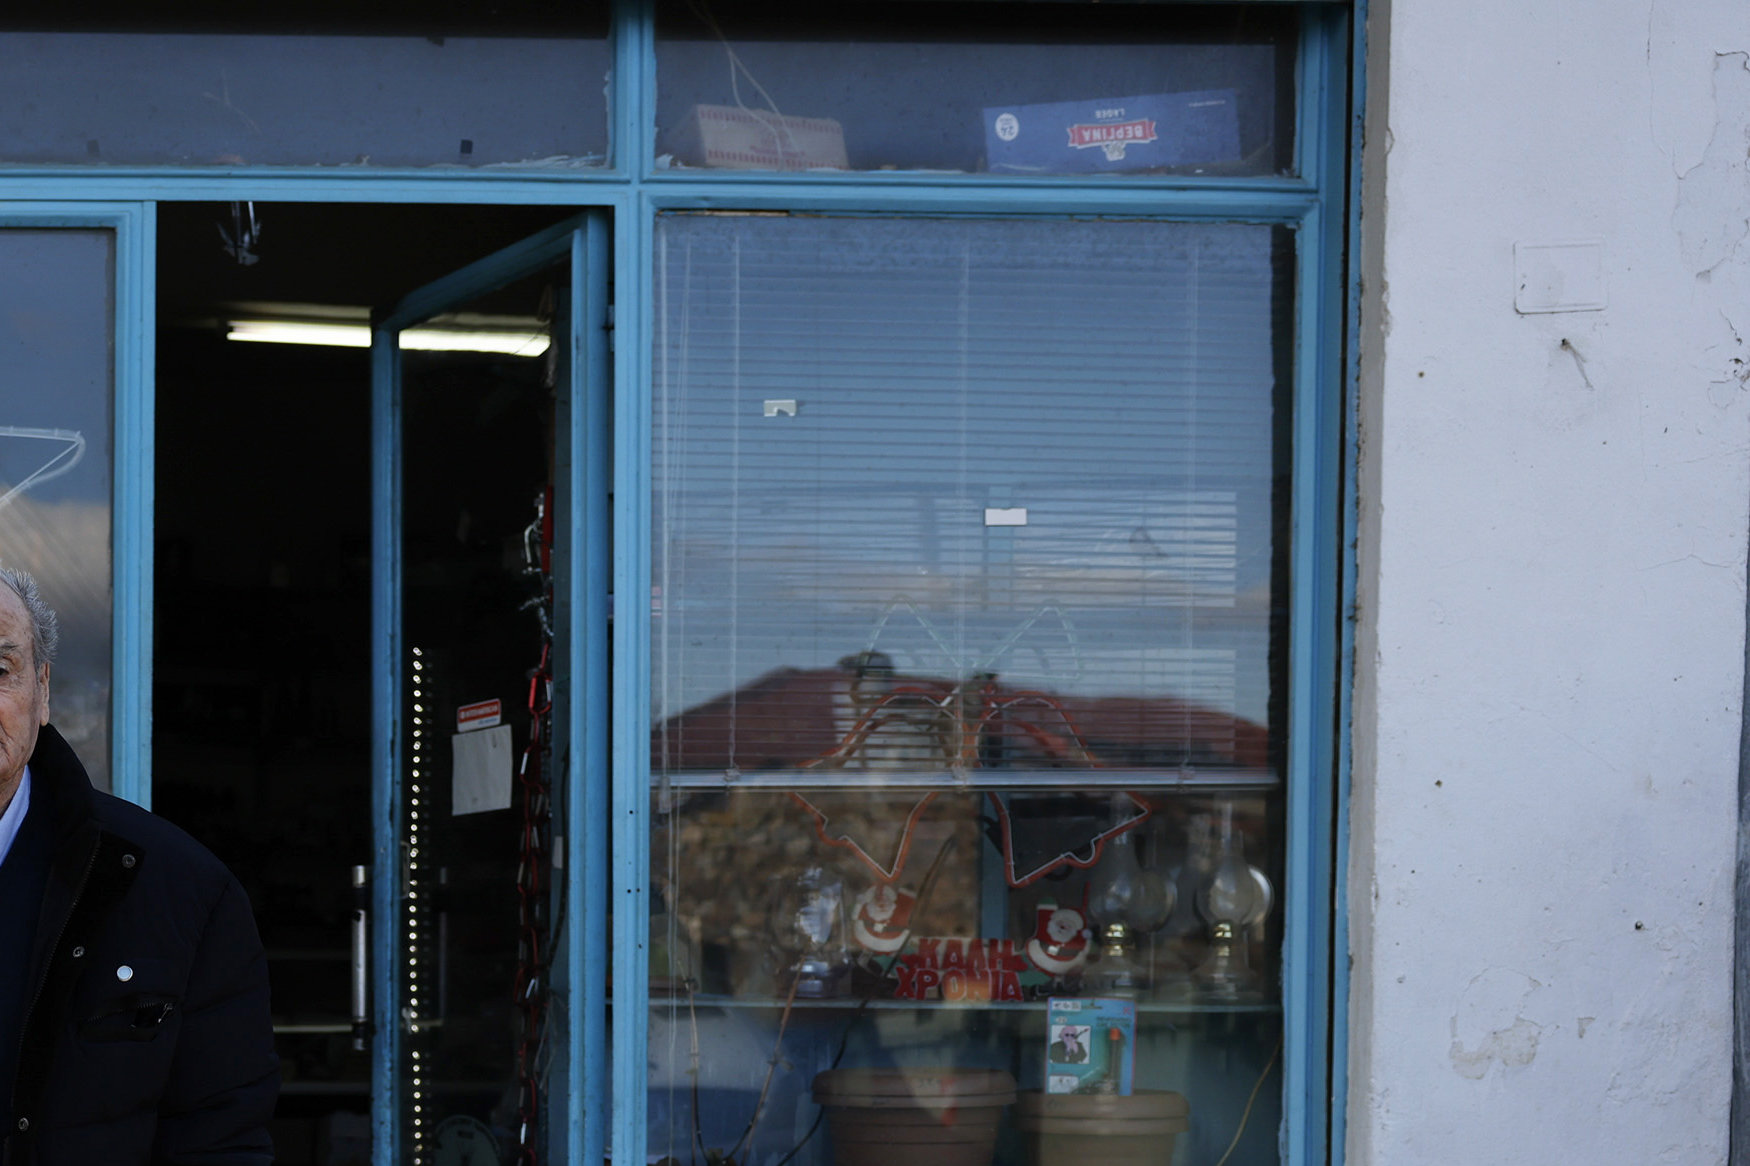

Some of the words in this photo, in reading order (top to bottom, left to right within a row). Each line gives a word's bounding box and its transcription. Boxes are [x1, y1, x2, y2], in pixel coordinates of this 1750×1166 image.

[1080, 124, 1145, 140] ΒΕΡΓΙΝΑ
[918, 938, 1014, 970] ΚΑΛΗ
[894, 966, 1025, 1001] ΧΡΟΝΙΑ
